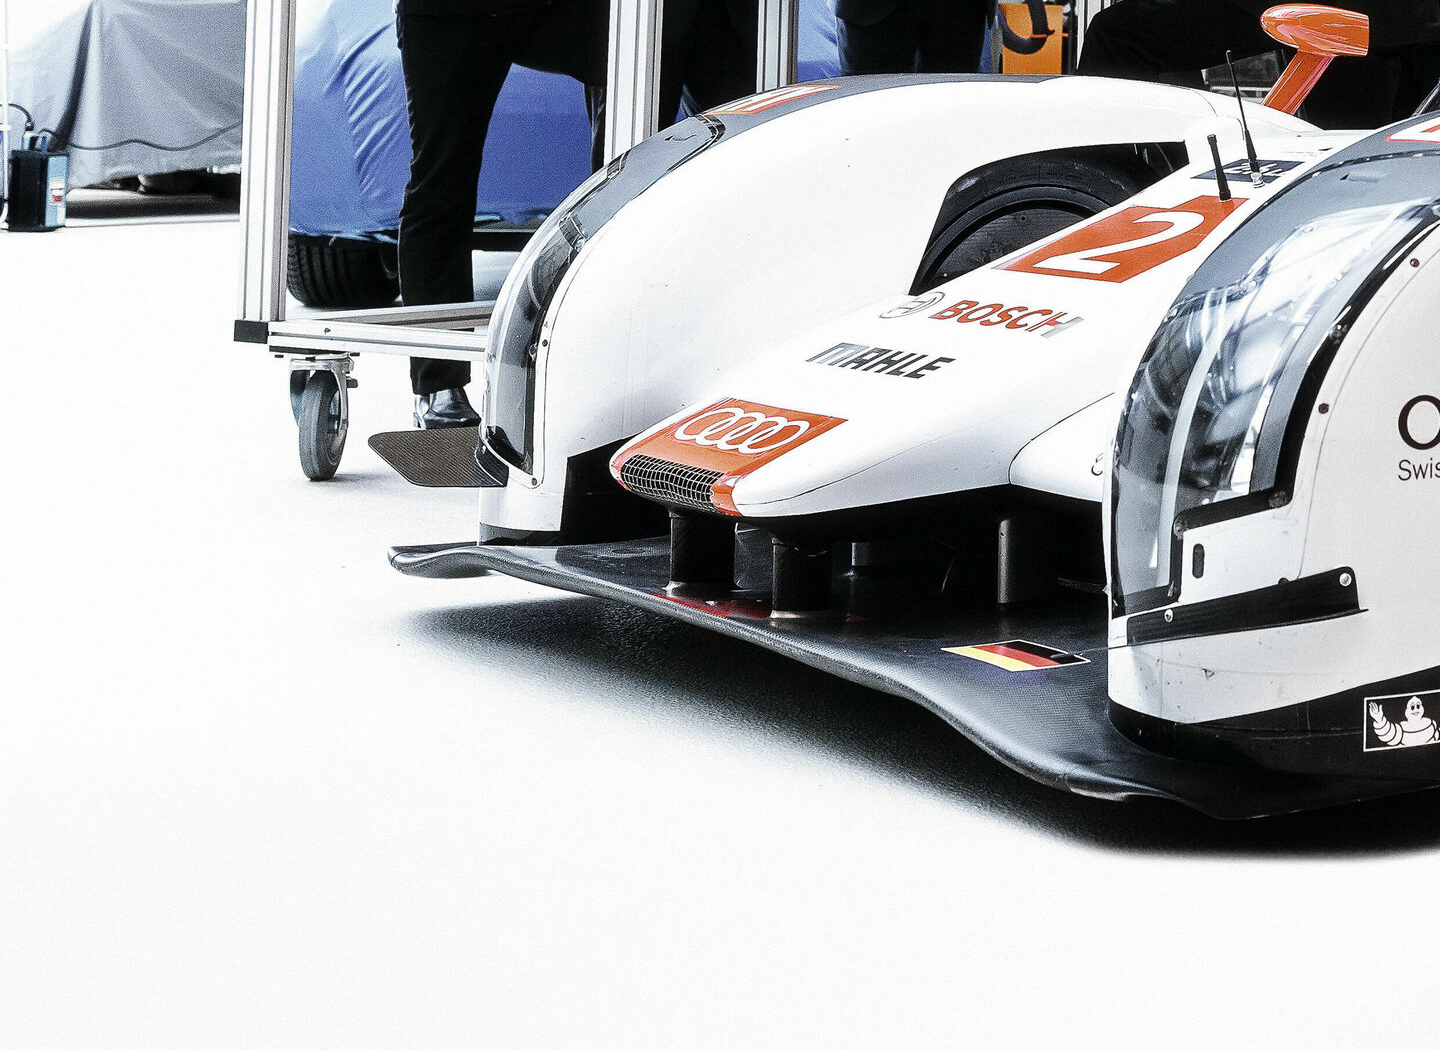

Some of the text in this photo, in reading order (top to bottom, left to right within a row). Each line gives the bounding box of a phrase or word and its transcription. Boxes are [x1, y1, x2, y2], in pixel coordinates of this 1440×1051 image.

[1032, 211, 1205, 275] 2
[928, 299, 1085, 339] BOSCH
[805, 342, 957, 379] MAHLE
